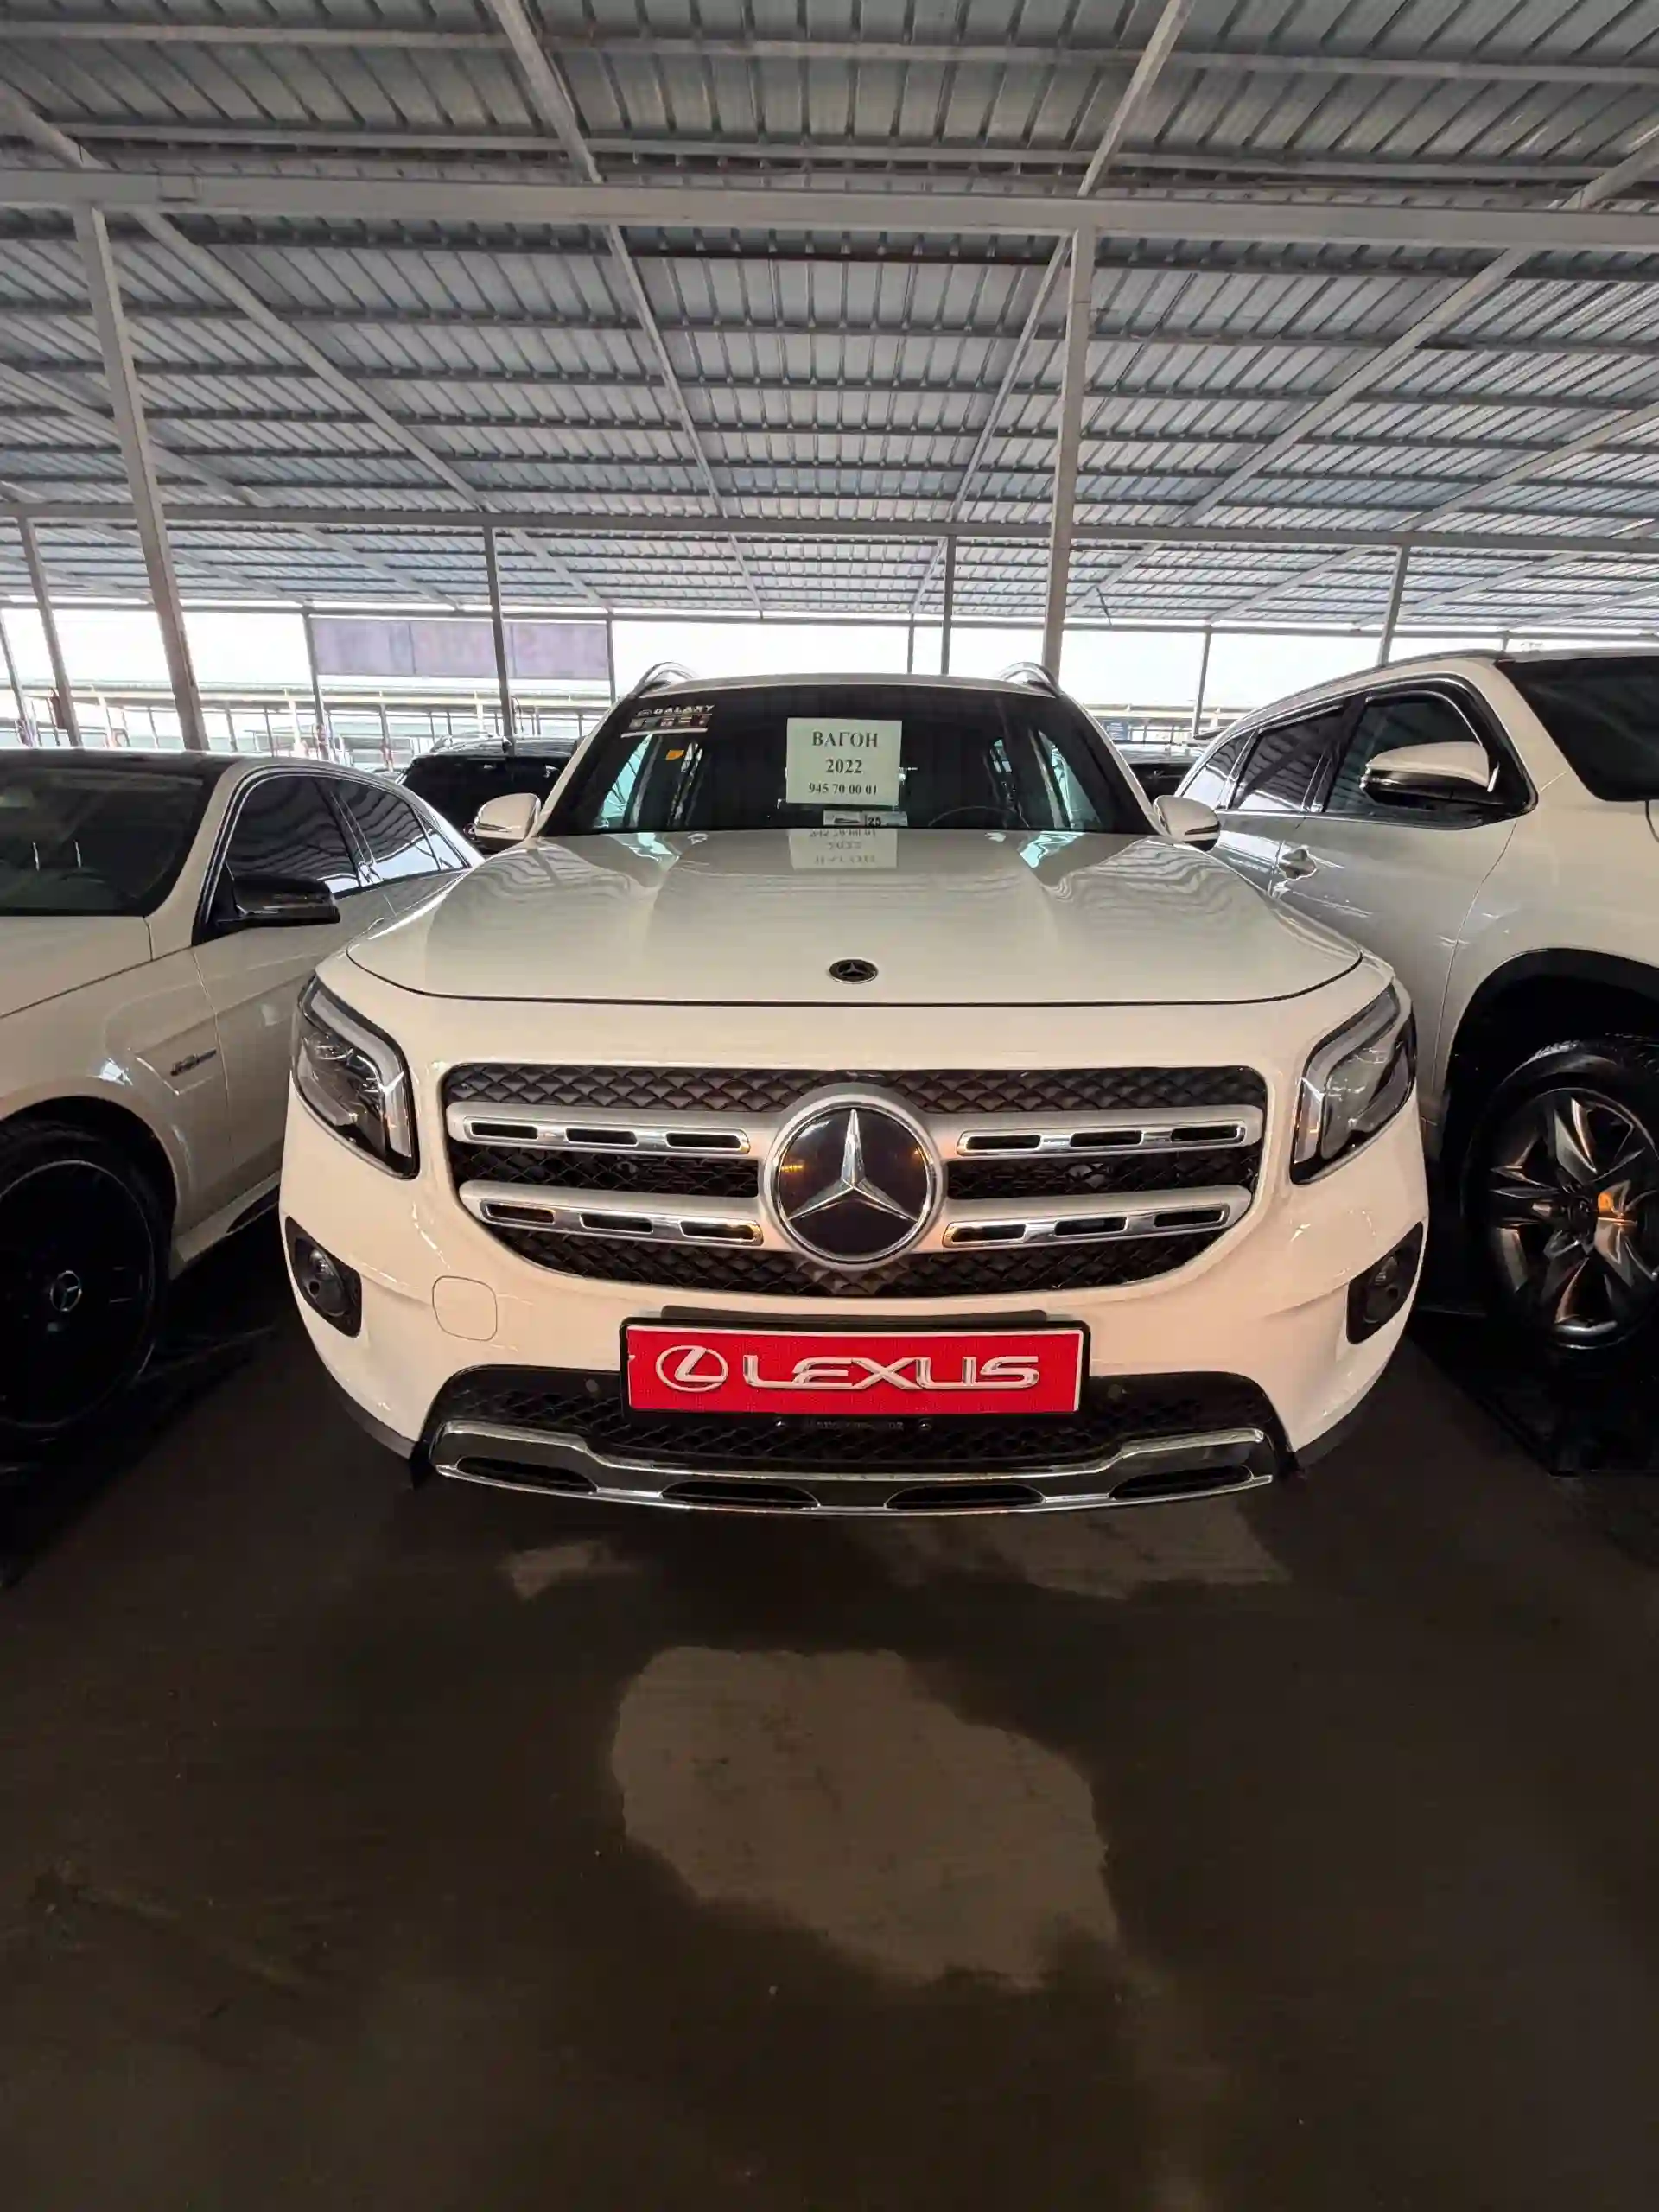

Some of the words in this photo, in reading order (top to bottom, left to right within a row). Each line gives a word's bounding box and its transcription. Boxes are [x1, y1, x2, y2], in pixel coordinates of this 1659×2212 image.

[812, 731, 879, 748] ВАГОН
[826, 759, 863, 774] 2022
[808, 782, 830, 794] 945
[833, 784, 846, 795] 70
[849, 784, 862, 795] 00
[865, 785, 878, 796] 01
[742, 1354, 1040, 1391] LEXUS
